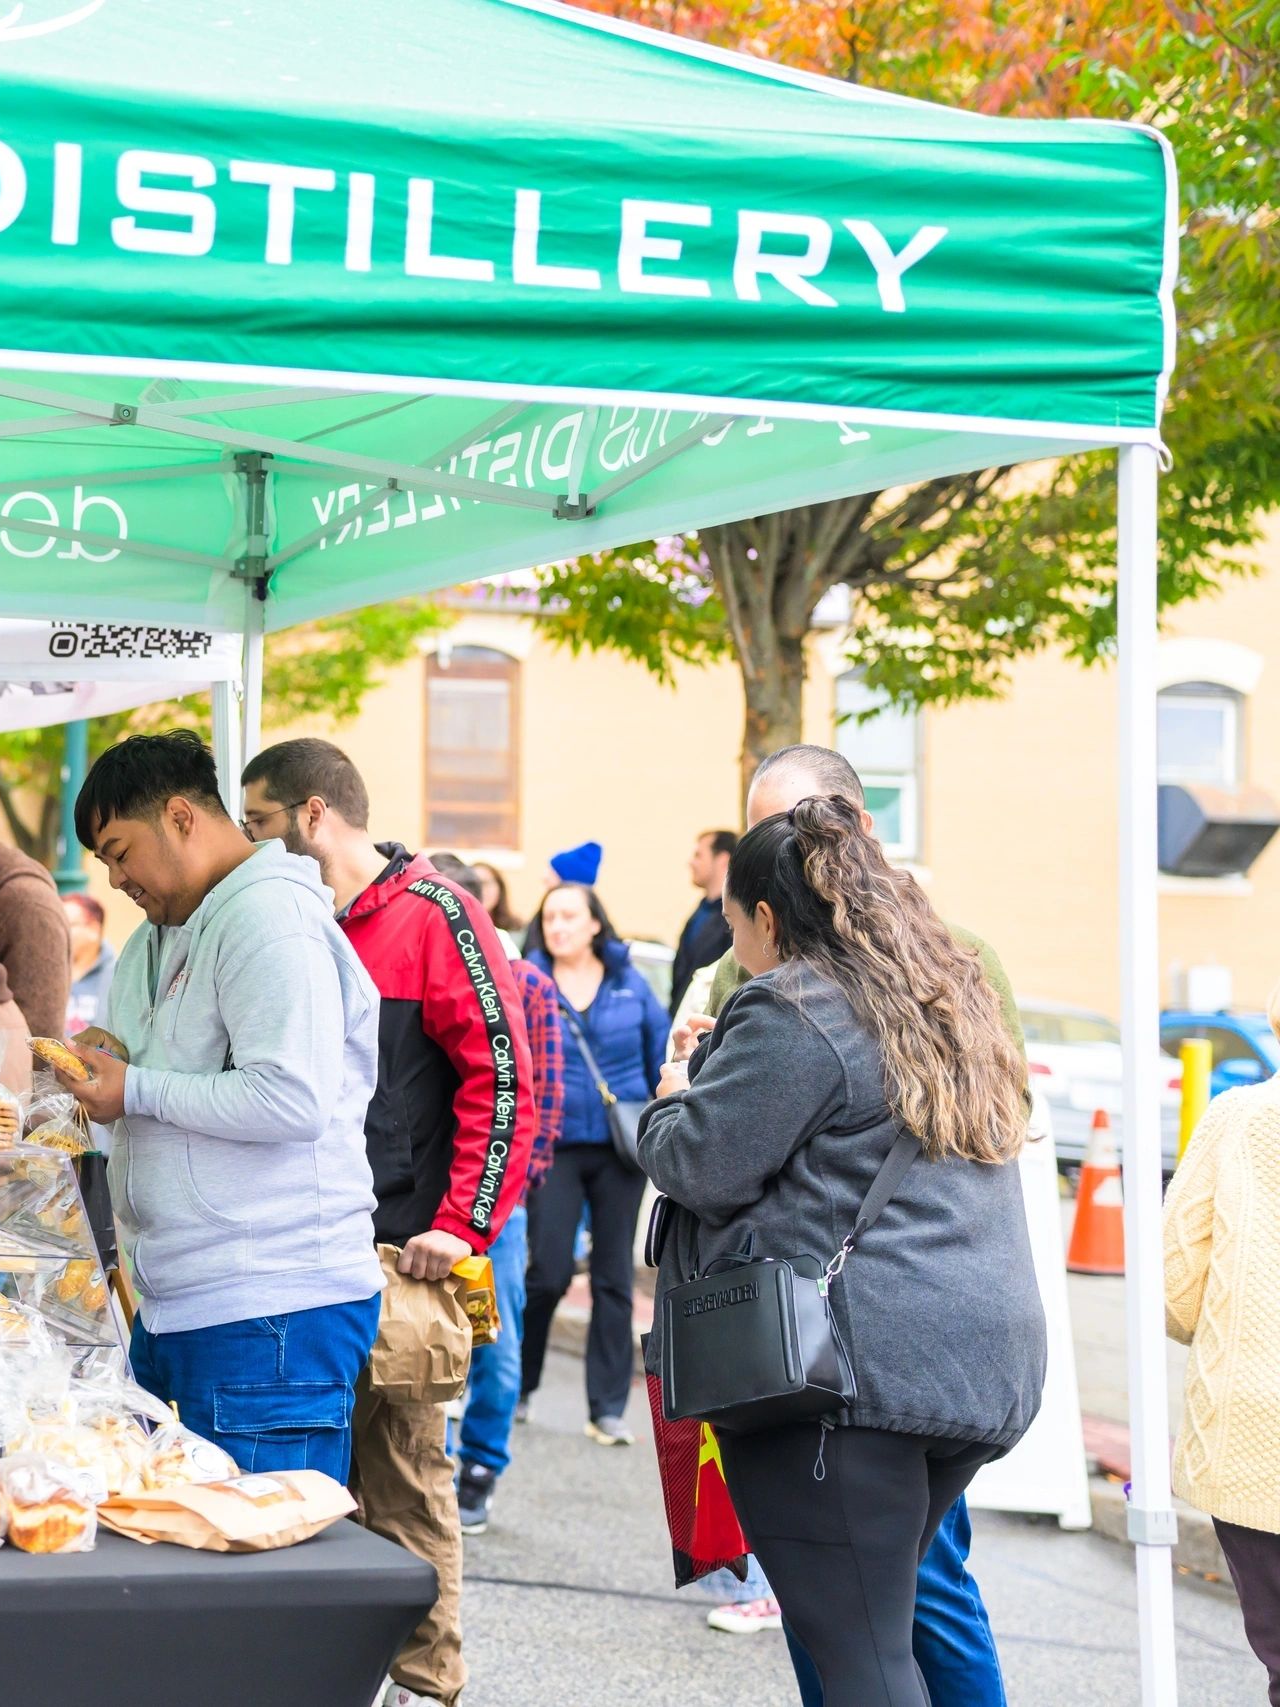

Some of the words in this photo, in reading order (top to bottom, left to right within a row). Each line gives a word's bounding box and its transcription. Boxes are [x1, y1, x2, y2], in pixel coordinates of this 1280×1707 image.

[431, 886, 461, 920] Klein
[456, 929, 486, 983] Calvin
[476, 982, 501, 1023] Klein
[492, 1034, 514, 1088] Calvin
[494, 1091, 515, 1129] Klein
[480, 1140, 508, 1193] Calvin
